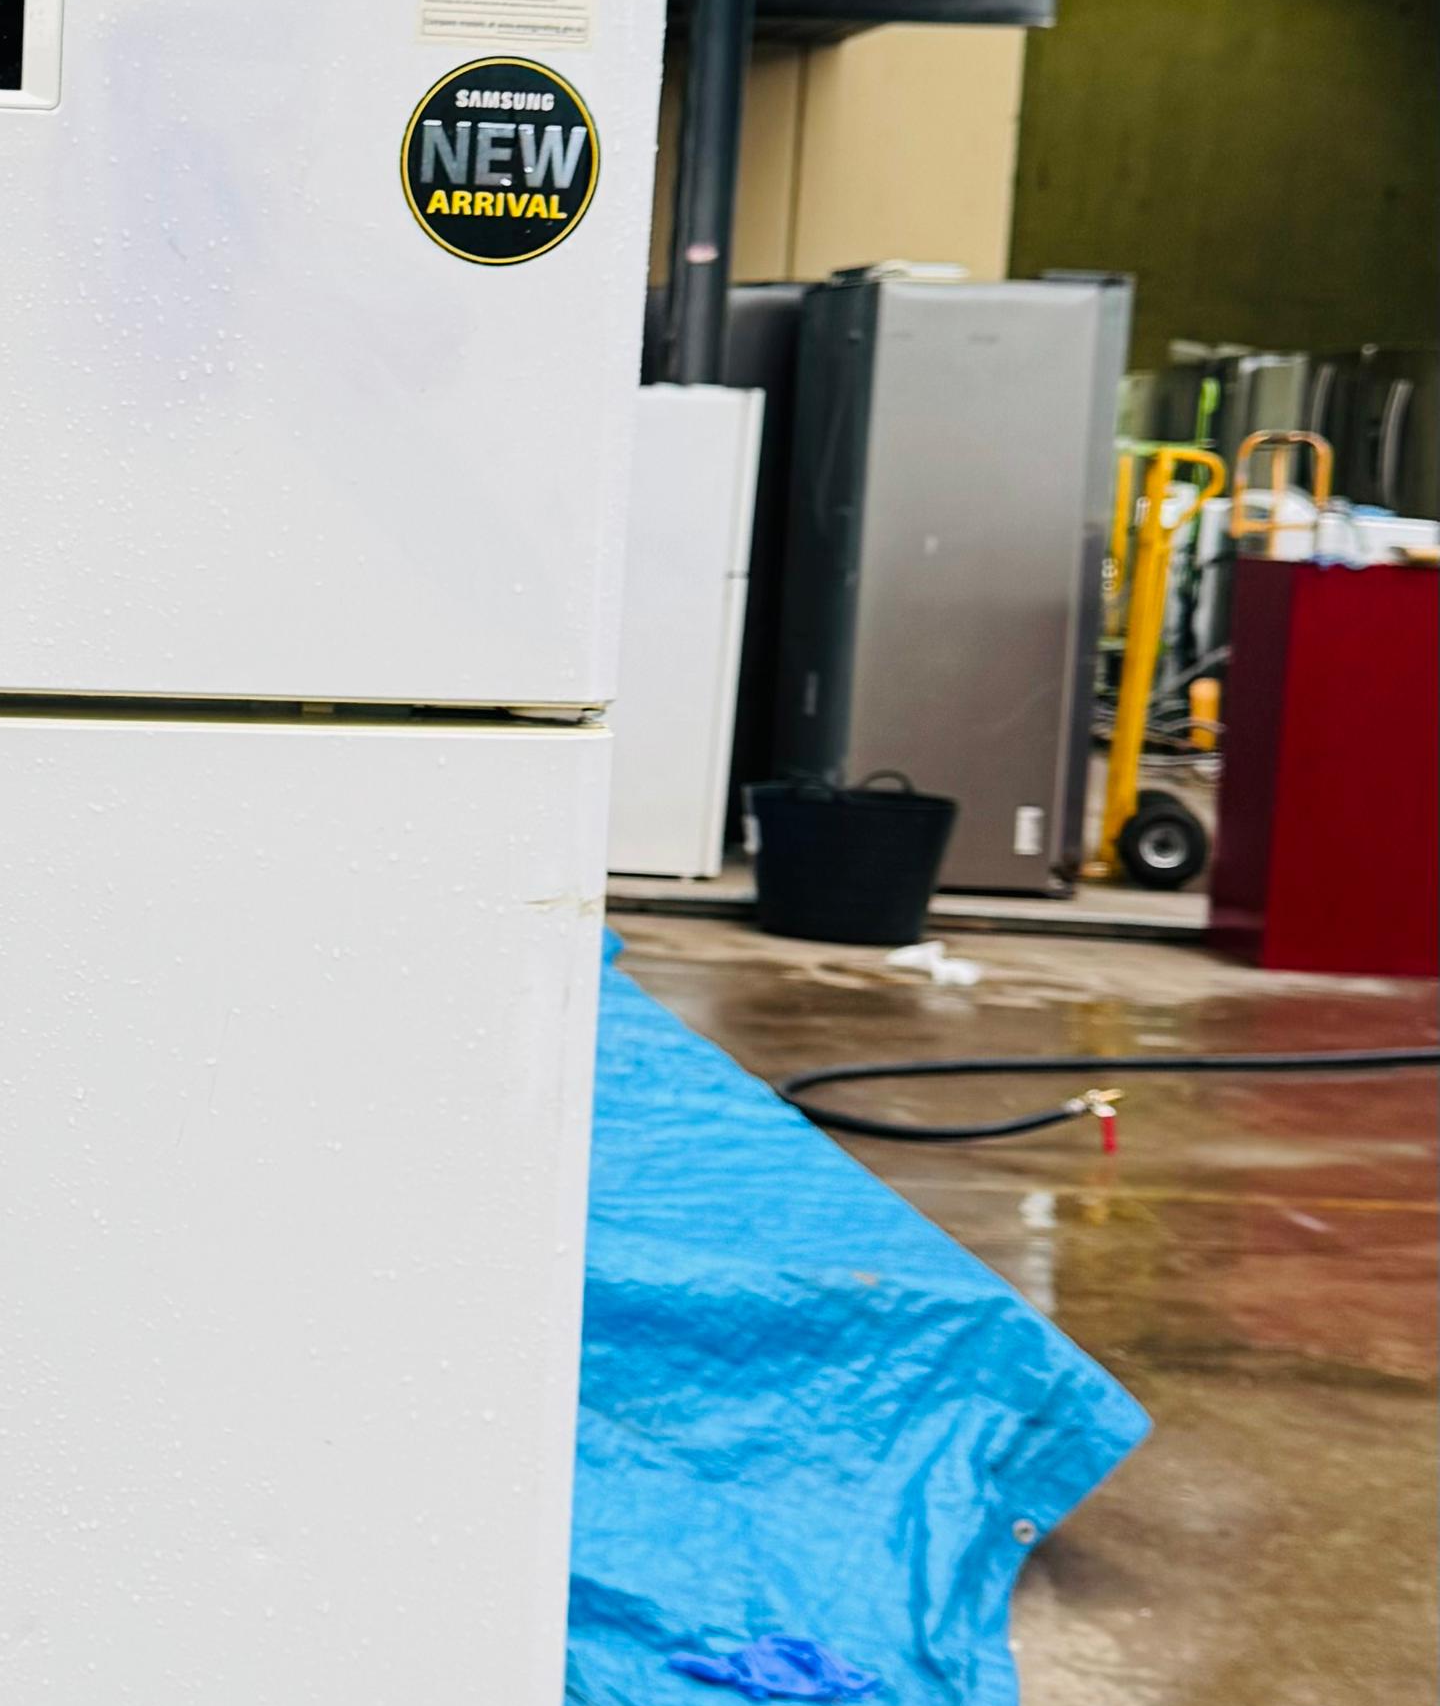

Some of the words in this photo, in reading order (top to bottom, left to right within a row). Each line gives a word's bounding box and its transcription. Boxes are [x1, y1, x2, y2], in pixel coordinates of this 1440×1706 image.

[455, 89, 555, 111] SAMSUNG
[420, 119, 587, 189] NEW
[426, 189, 568, 219] ARRIVAL
